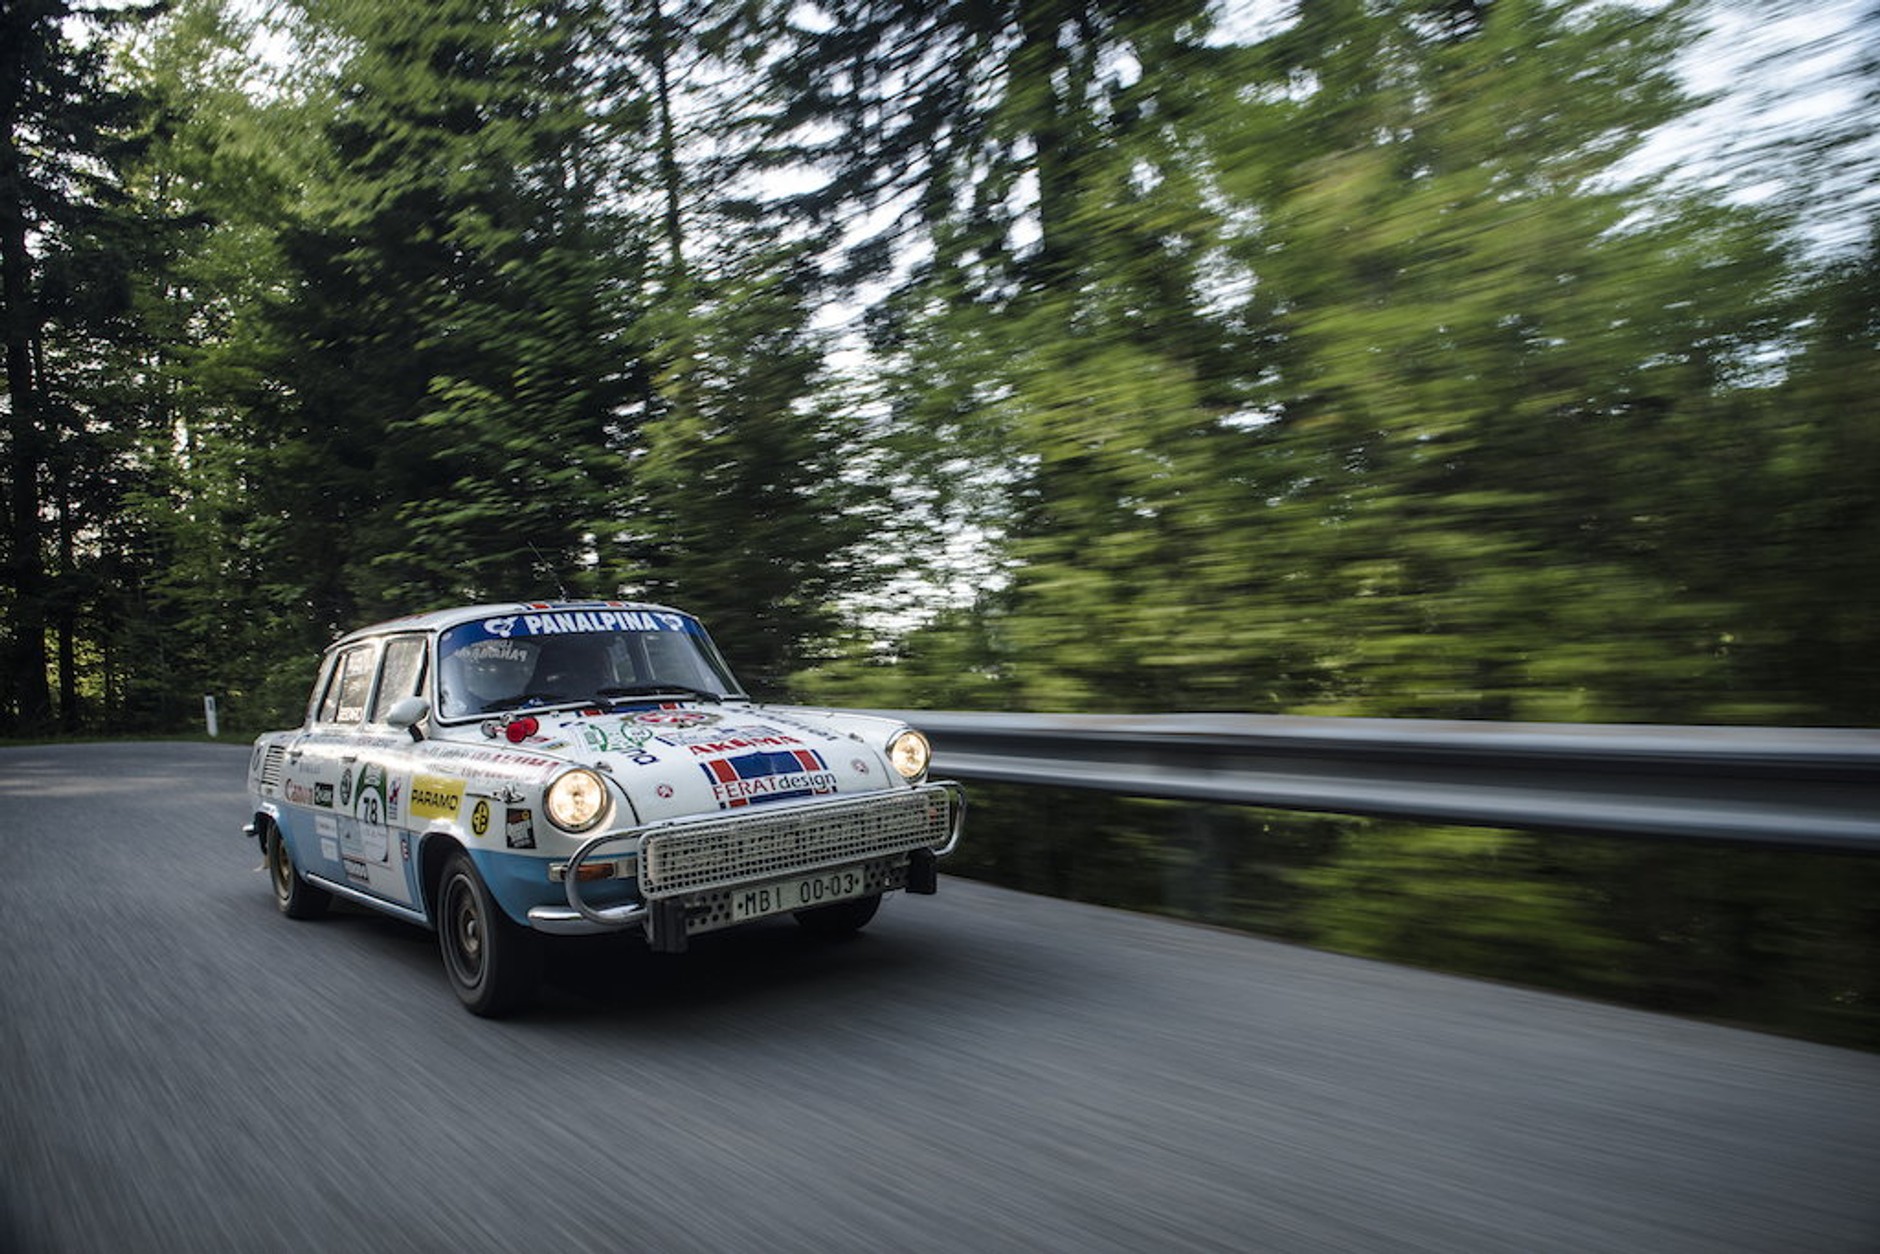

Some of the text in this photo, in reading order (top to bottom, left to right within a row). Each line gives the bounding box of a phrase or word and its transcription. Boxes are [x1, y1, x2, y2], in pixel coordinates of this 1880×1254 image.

[523, 611, 661, 635] PANALPINA
[411, 788, 459, 811] PARAMO
[712, 772, 837, 801] FERATdesign
[363, 796, 378, 825] 78
[800, 873, 854, 903] 00-03
